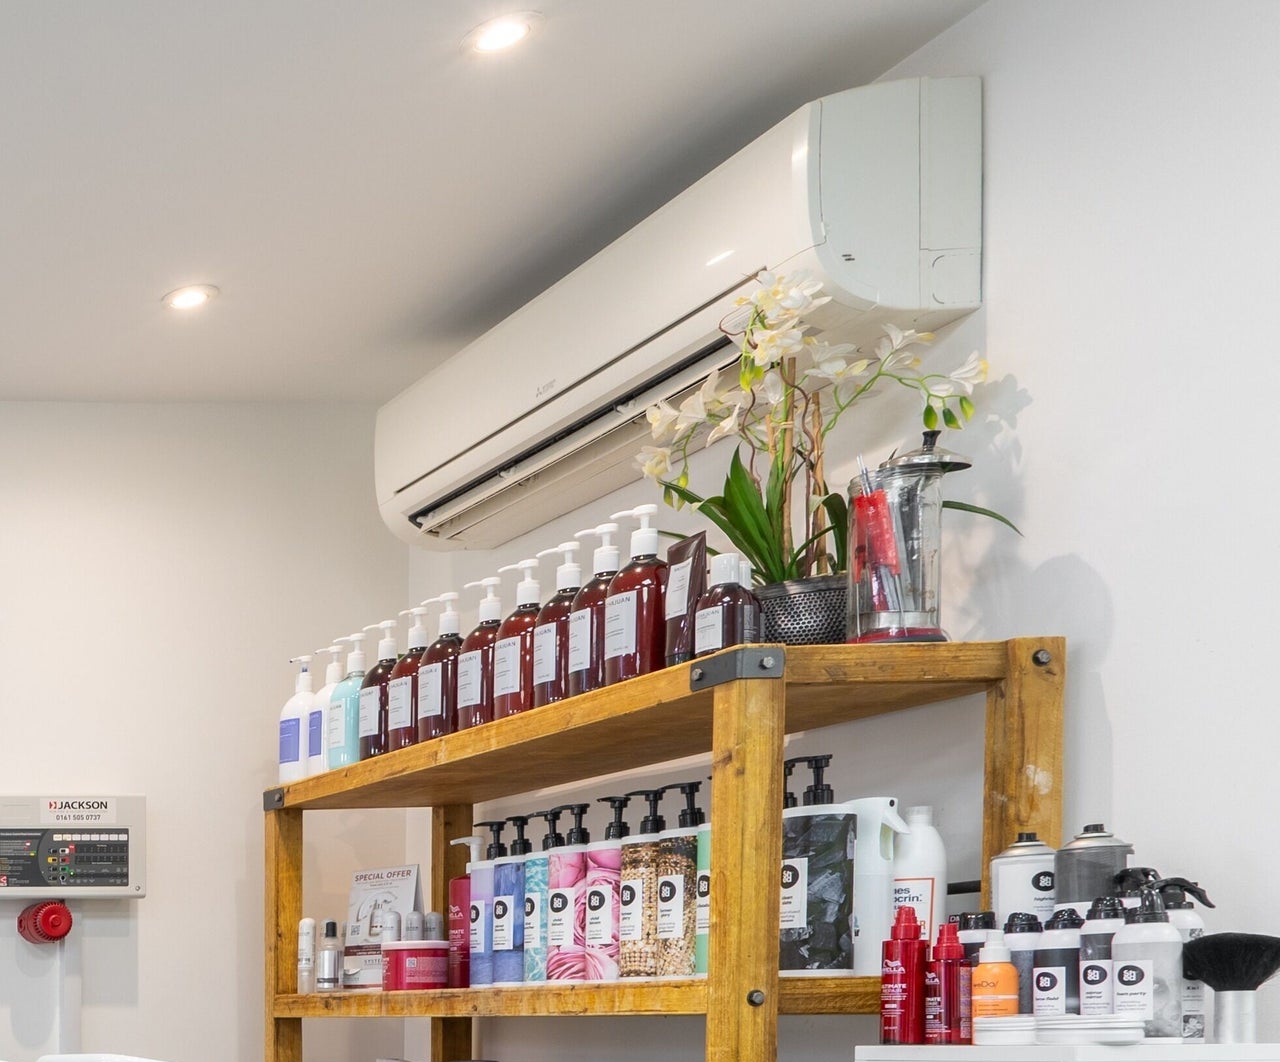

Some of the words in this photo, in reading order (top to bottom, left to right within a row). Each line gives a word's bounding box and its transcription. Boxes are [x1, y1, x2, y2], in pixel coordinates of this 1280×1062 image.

[58, 801, 108, 809] JACKSON
[354, 873, 384, 882] SPECIAL
[386, 869, 411, 878] OFFER
